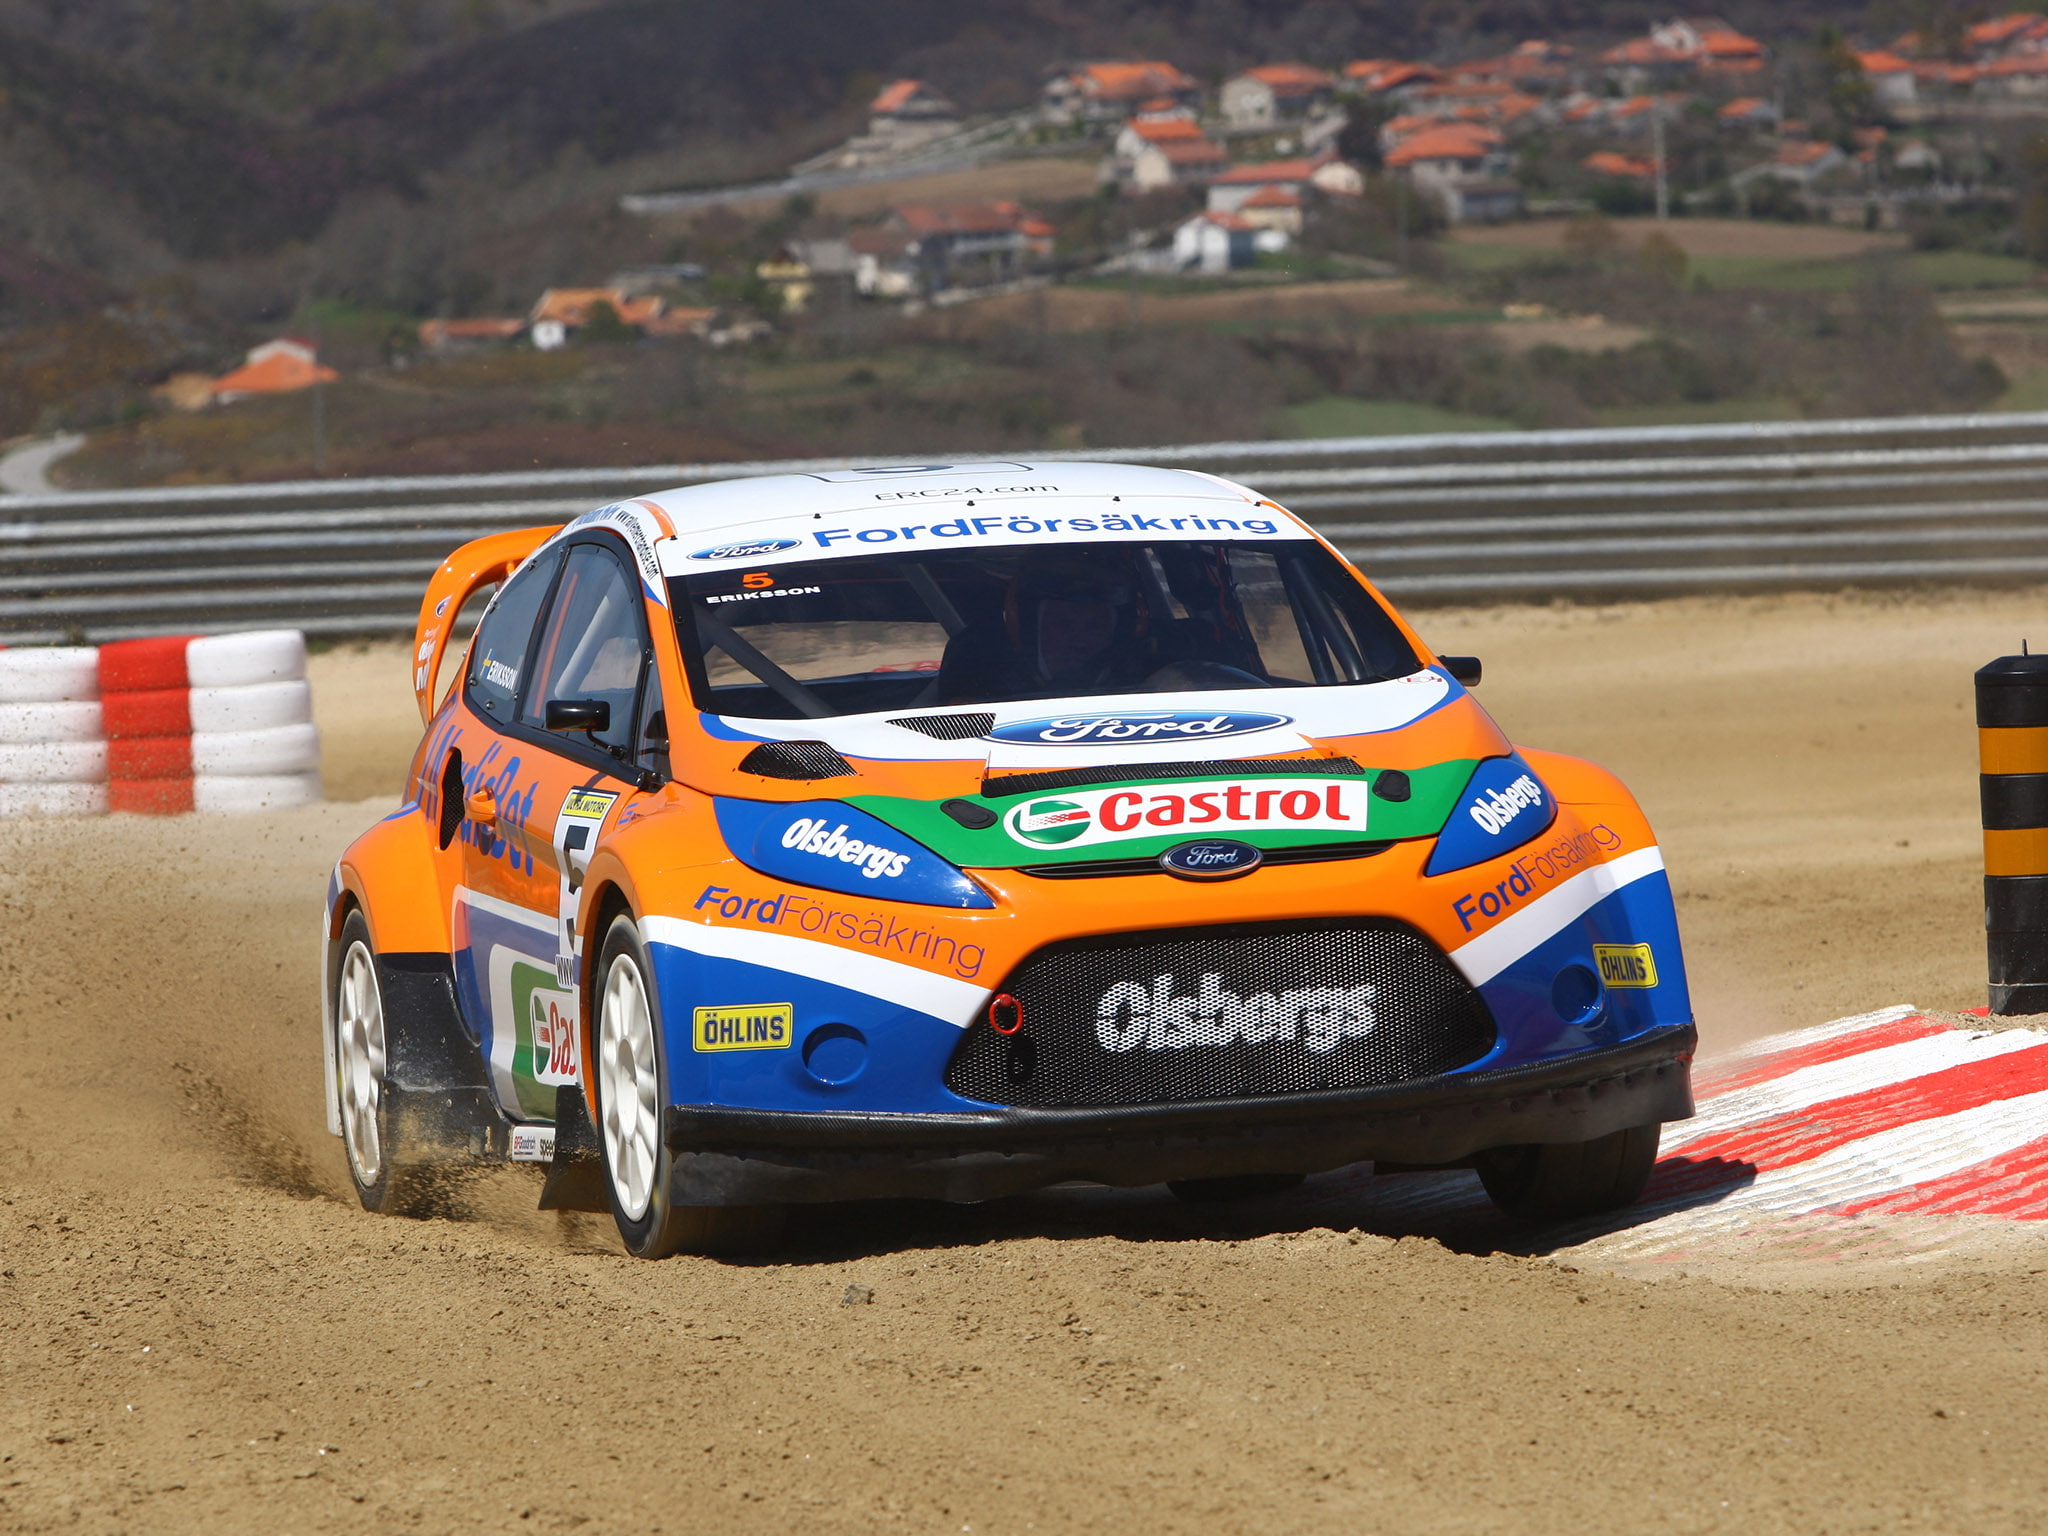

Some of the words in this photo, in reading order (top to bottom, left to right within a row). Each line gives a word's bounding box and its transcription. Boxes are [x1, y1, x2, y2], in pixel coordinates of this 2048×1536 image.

[874, 484, 1060, 501] ERC24.com
[812, 513, 1279, 548] FordFörsäkring
[709, 540, 781, 560] Ford
[705, 586, 822, 605] ERIKSSON
[741, 571, 776, 590] 5
[486, 660, 519, 692] ERIKSSON
[1039, 712, 1235, 743] Ford
[1098, 784, 1351, 833] Castrol
[1468, 774, 1543, 836] Olsbergs
[780, 817, 911, 879] Olsbergs
[1186, 845, 1240, 867] Ford
[1451, 823, 1623, 933] FordFörsäkring
[692, 884, 986, 979] FordFörsäkring
[1599, 950, 1647, 982] ÖHLINS
[704, 1012, 785, 1046] ÖHLINS
[1095, 972, 1379, 1053] Olsbergs
